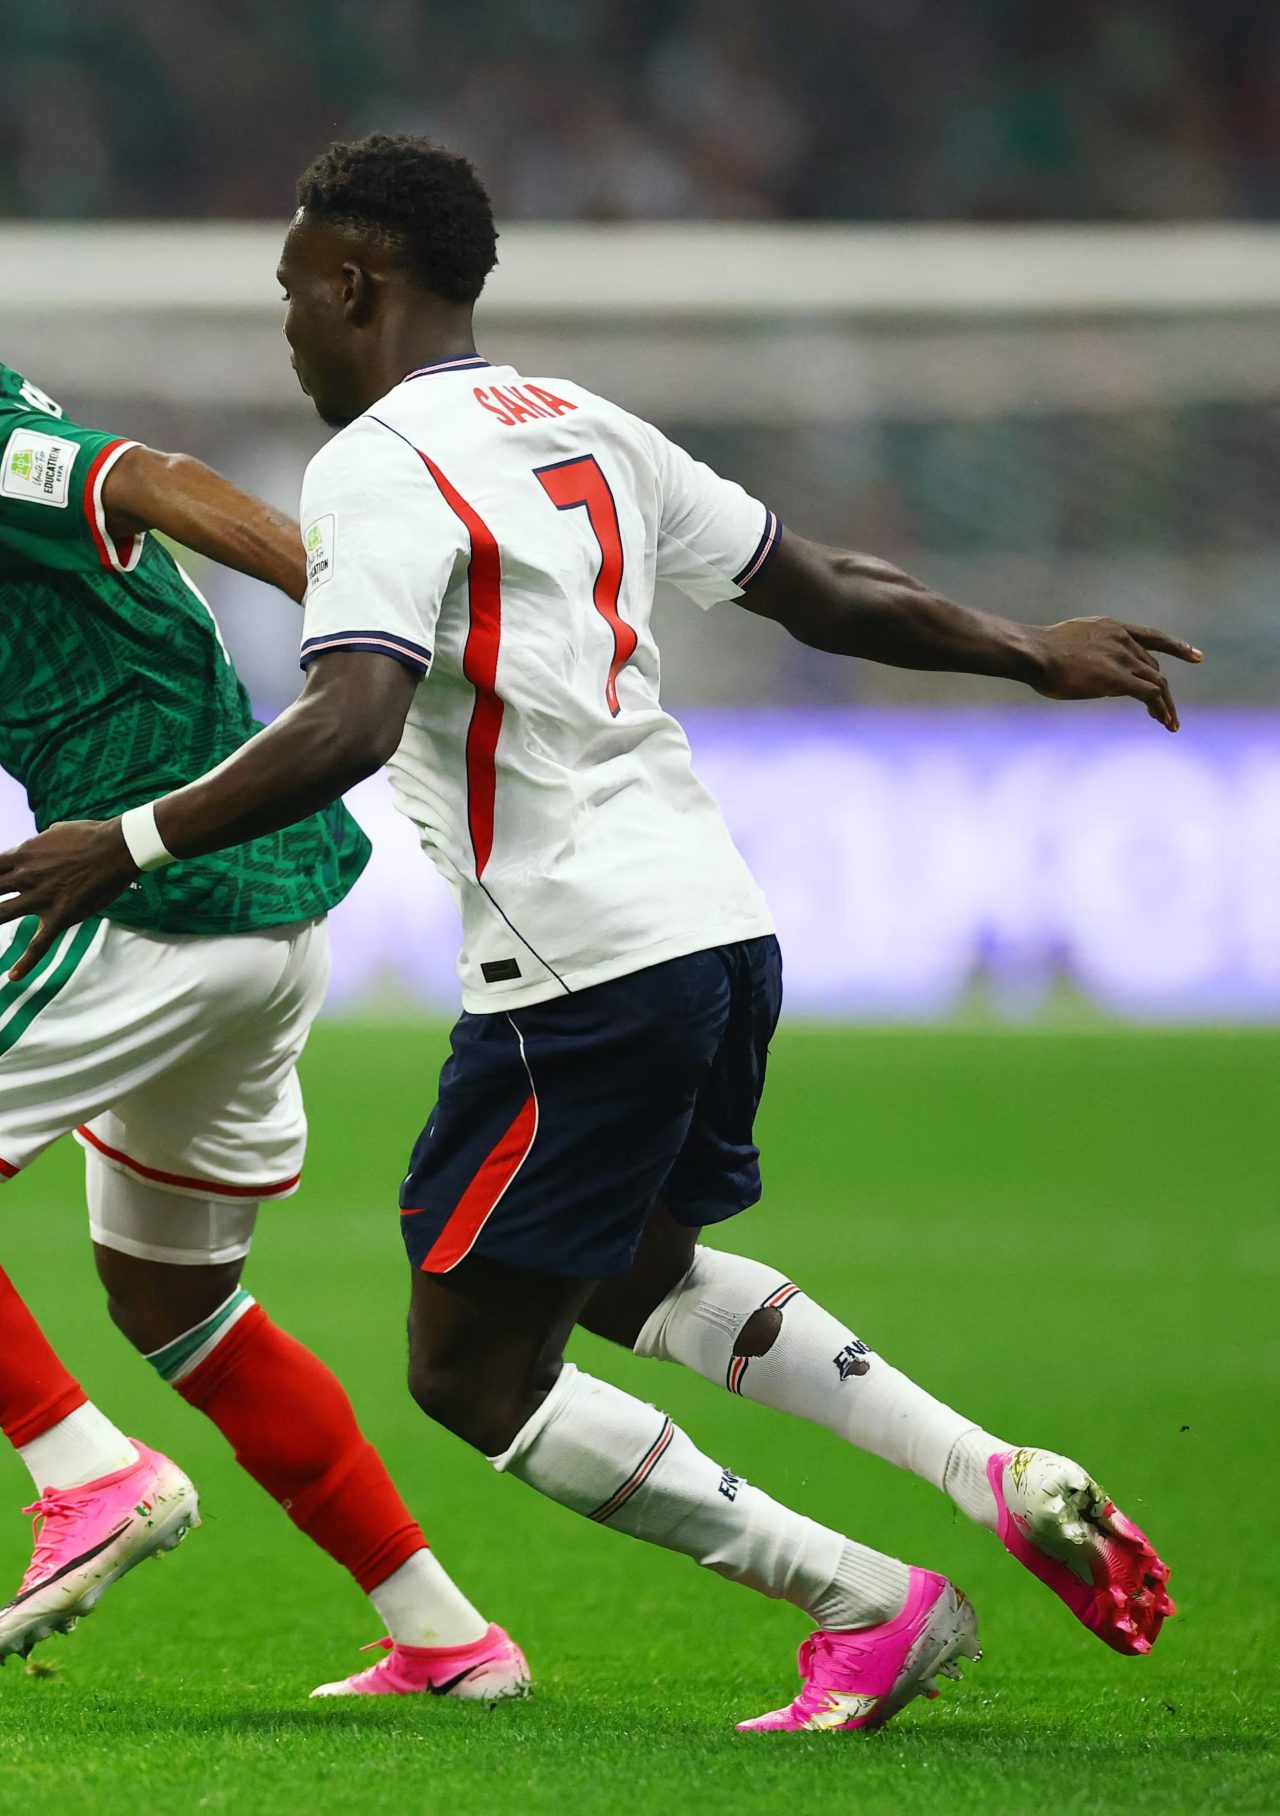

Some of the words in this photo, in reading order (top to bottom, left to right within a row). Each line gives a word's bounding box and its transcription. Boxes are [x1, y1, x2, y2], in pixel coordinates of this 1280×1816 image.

[473, 384, 578, 426] SAKA
[43, 447, 61, 494] EDUCATION
[56, 465, 64, 482] FIFA
[532, 453, 638, 719] 7
[718, 1470, 739, 1502] EN
